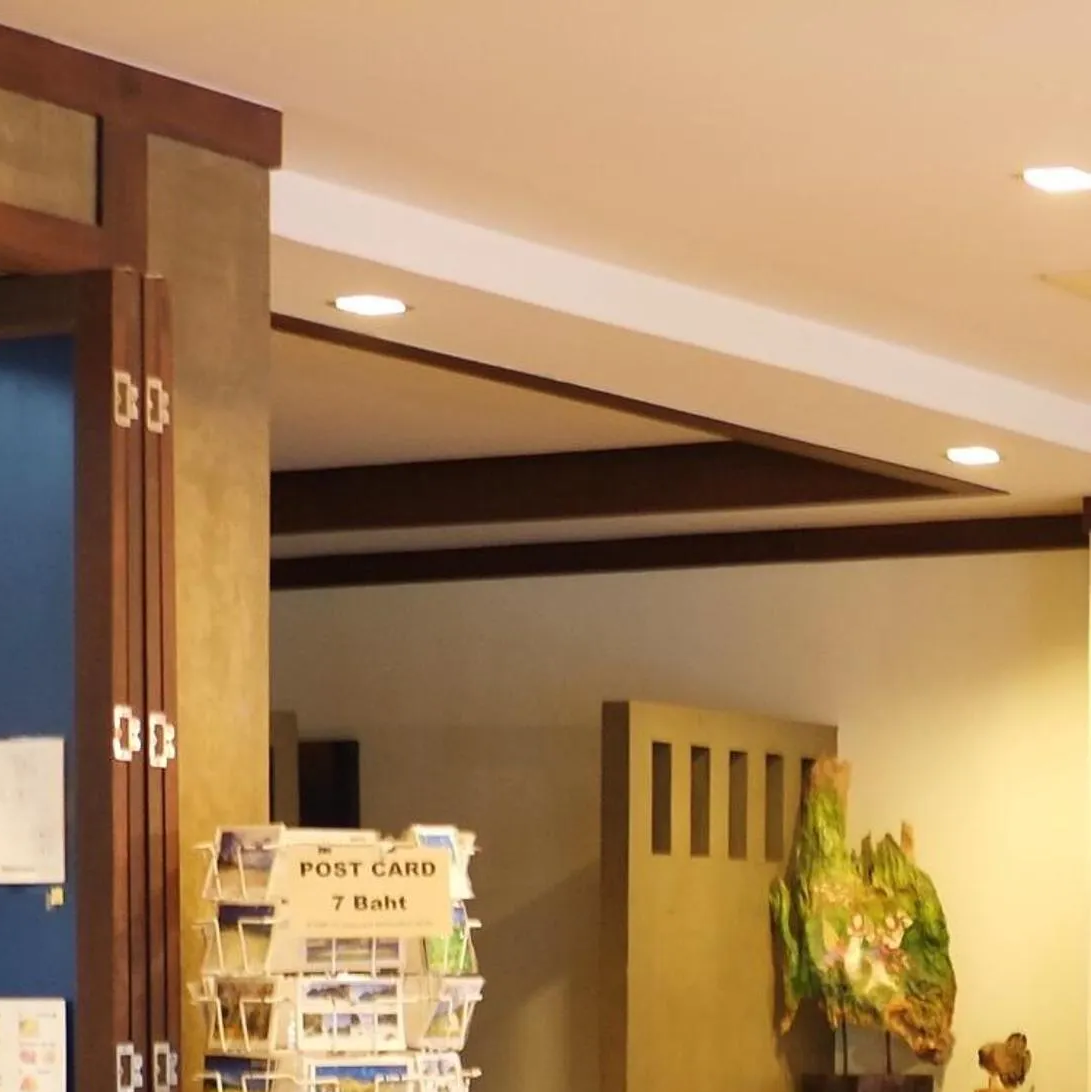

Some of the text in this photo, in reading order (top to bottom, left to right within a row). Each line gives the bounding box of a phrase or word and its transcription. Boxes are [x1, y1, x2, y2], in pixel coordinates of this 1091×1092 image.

[300, 861, 436, 877] POST CARD
[332, 895, 407, 911] 7 Baht
